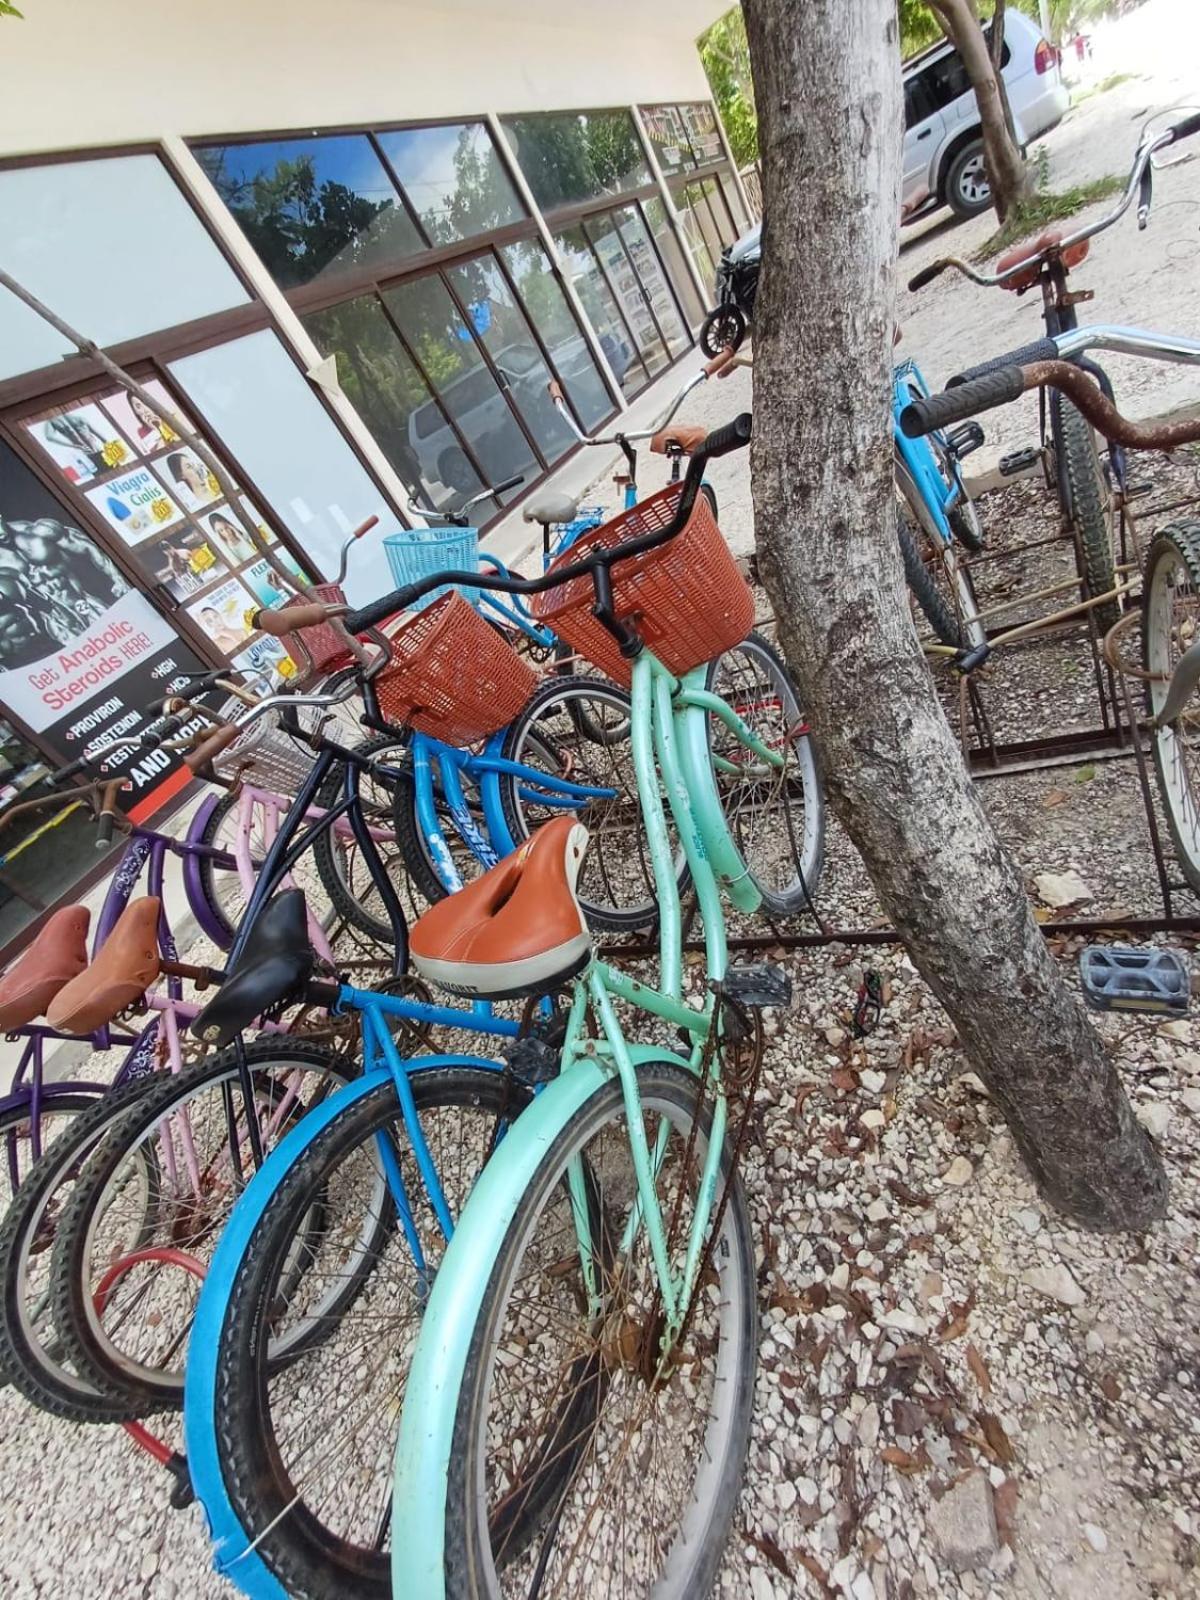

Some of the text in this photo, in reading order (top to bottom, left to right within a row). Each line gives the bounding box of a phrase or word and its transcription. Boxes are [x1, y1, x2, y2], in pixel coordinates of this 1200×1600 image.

[106, 472, 150, 496] Viagra
[130, 486, 162, 506] Cialis
[28, 620, 133, 690] Get Anabolic
[42, 631, 154, 710] Steroids HERE!
[154, 657, 177, 678] HGH
[69, 696, 124, 738] PROVIRON
[87, 709, 143, 753] SOSTENON
[130, 748, 171, 787] AND
